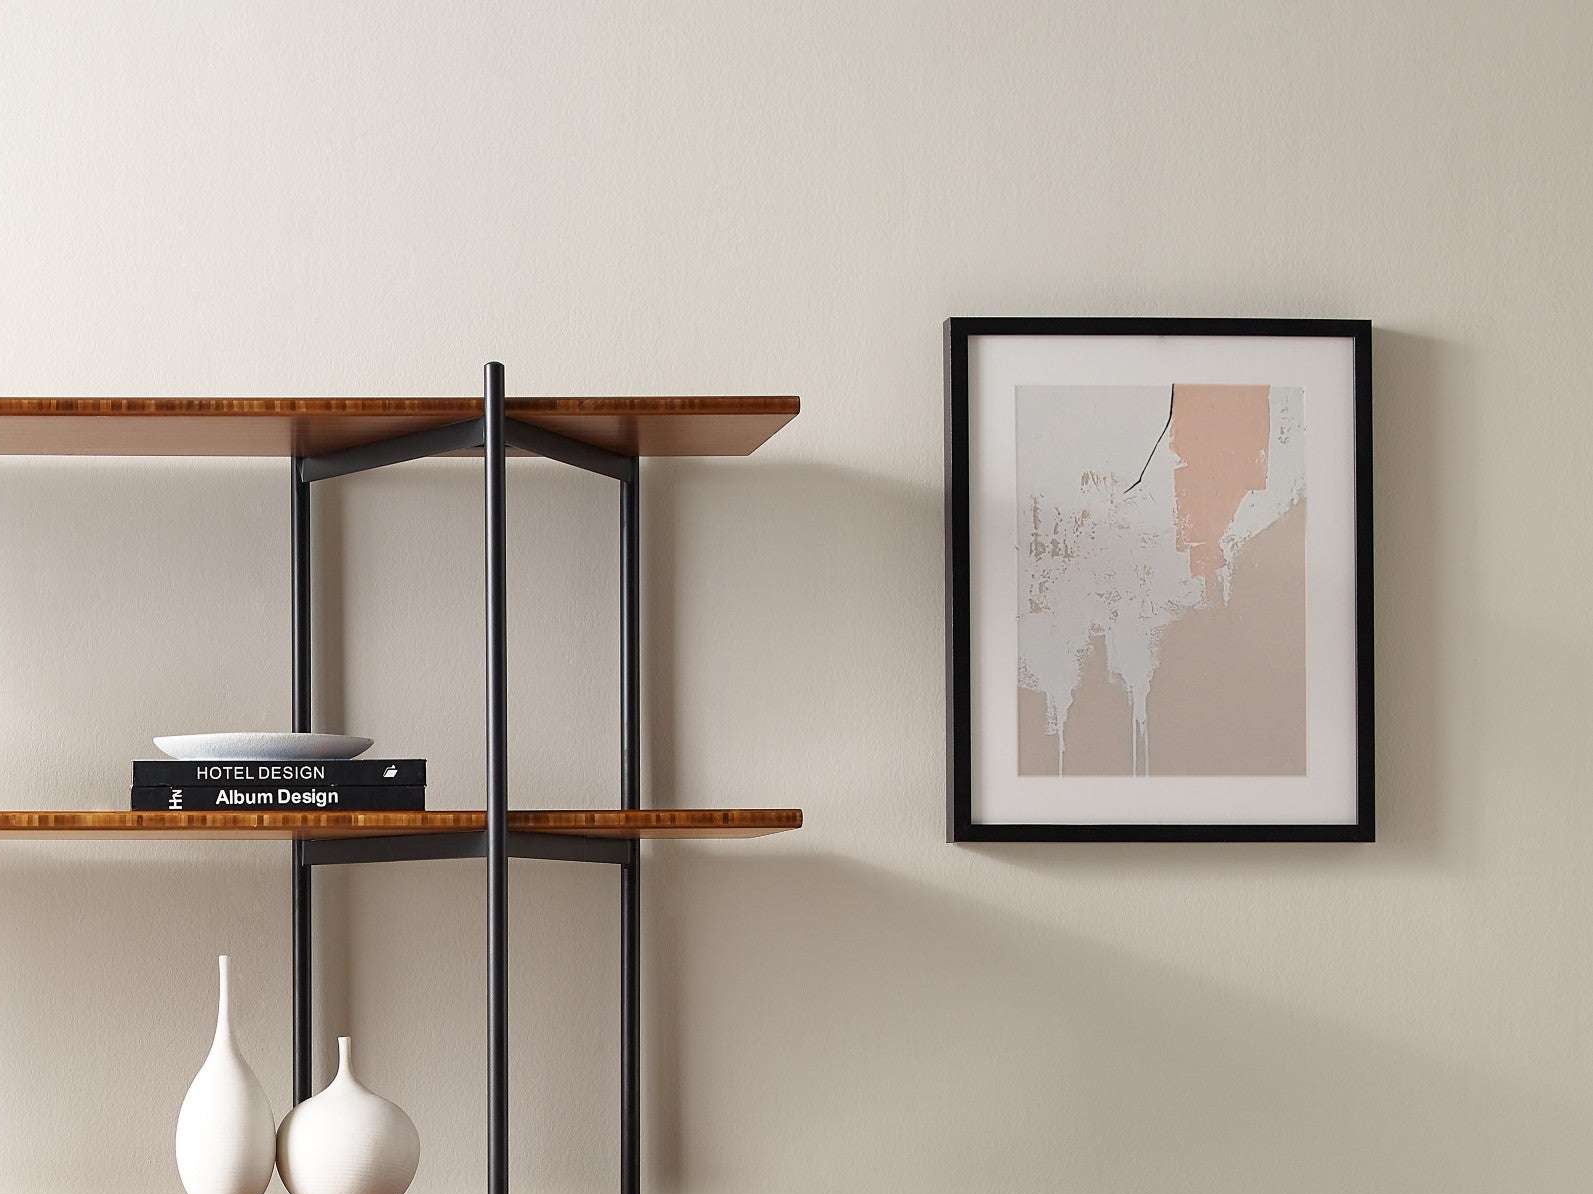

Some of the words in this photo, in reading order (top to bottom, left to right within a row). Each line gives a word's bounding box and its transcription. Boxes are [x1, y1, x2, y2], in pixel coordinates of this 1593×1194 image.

[196, 765, 255, 780] HOTEL
[258, 765, 326, 780] DESIGN
[215, 788, 274, 805] Album
[277, 788, 339, 807] Design
